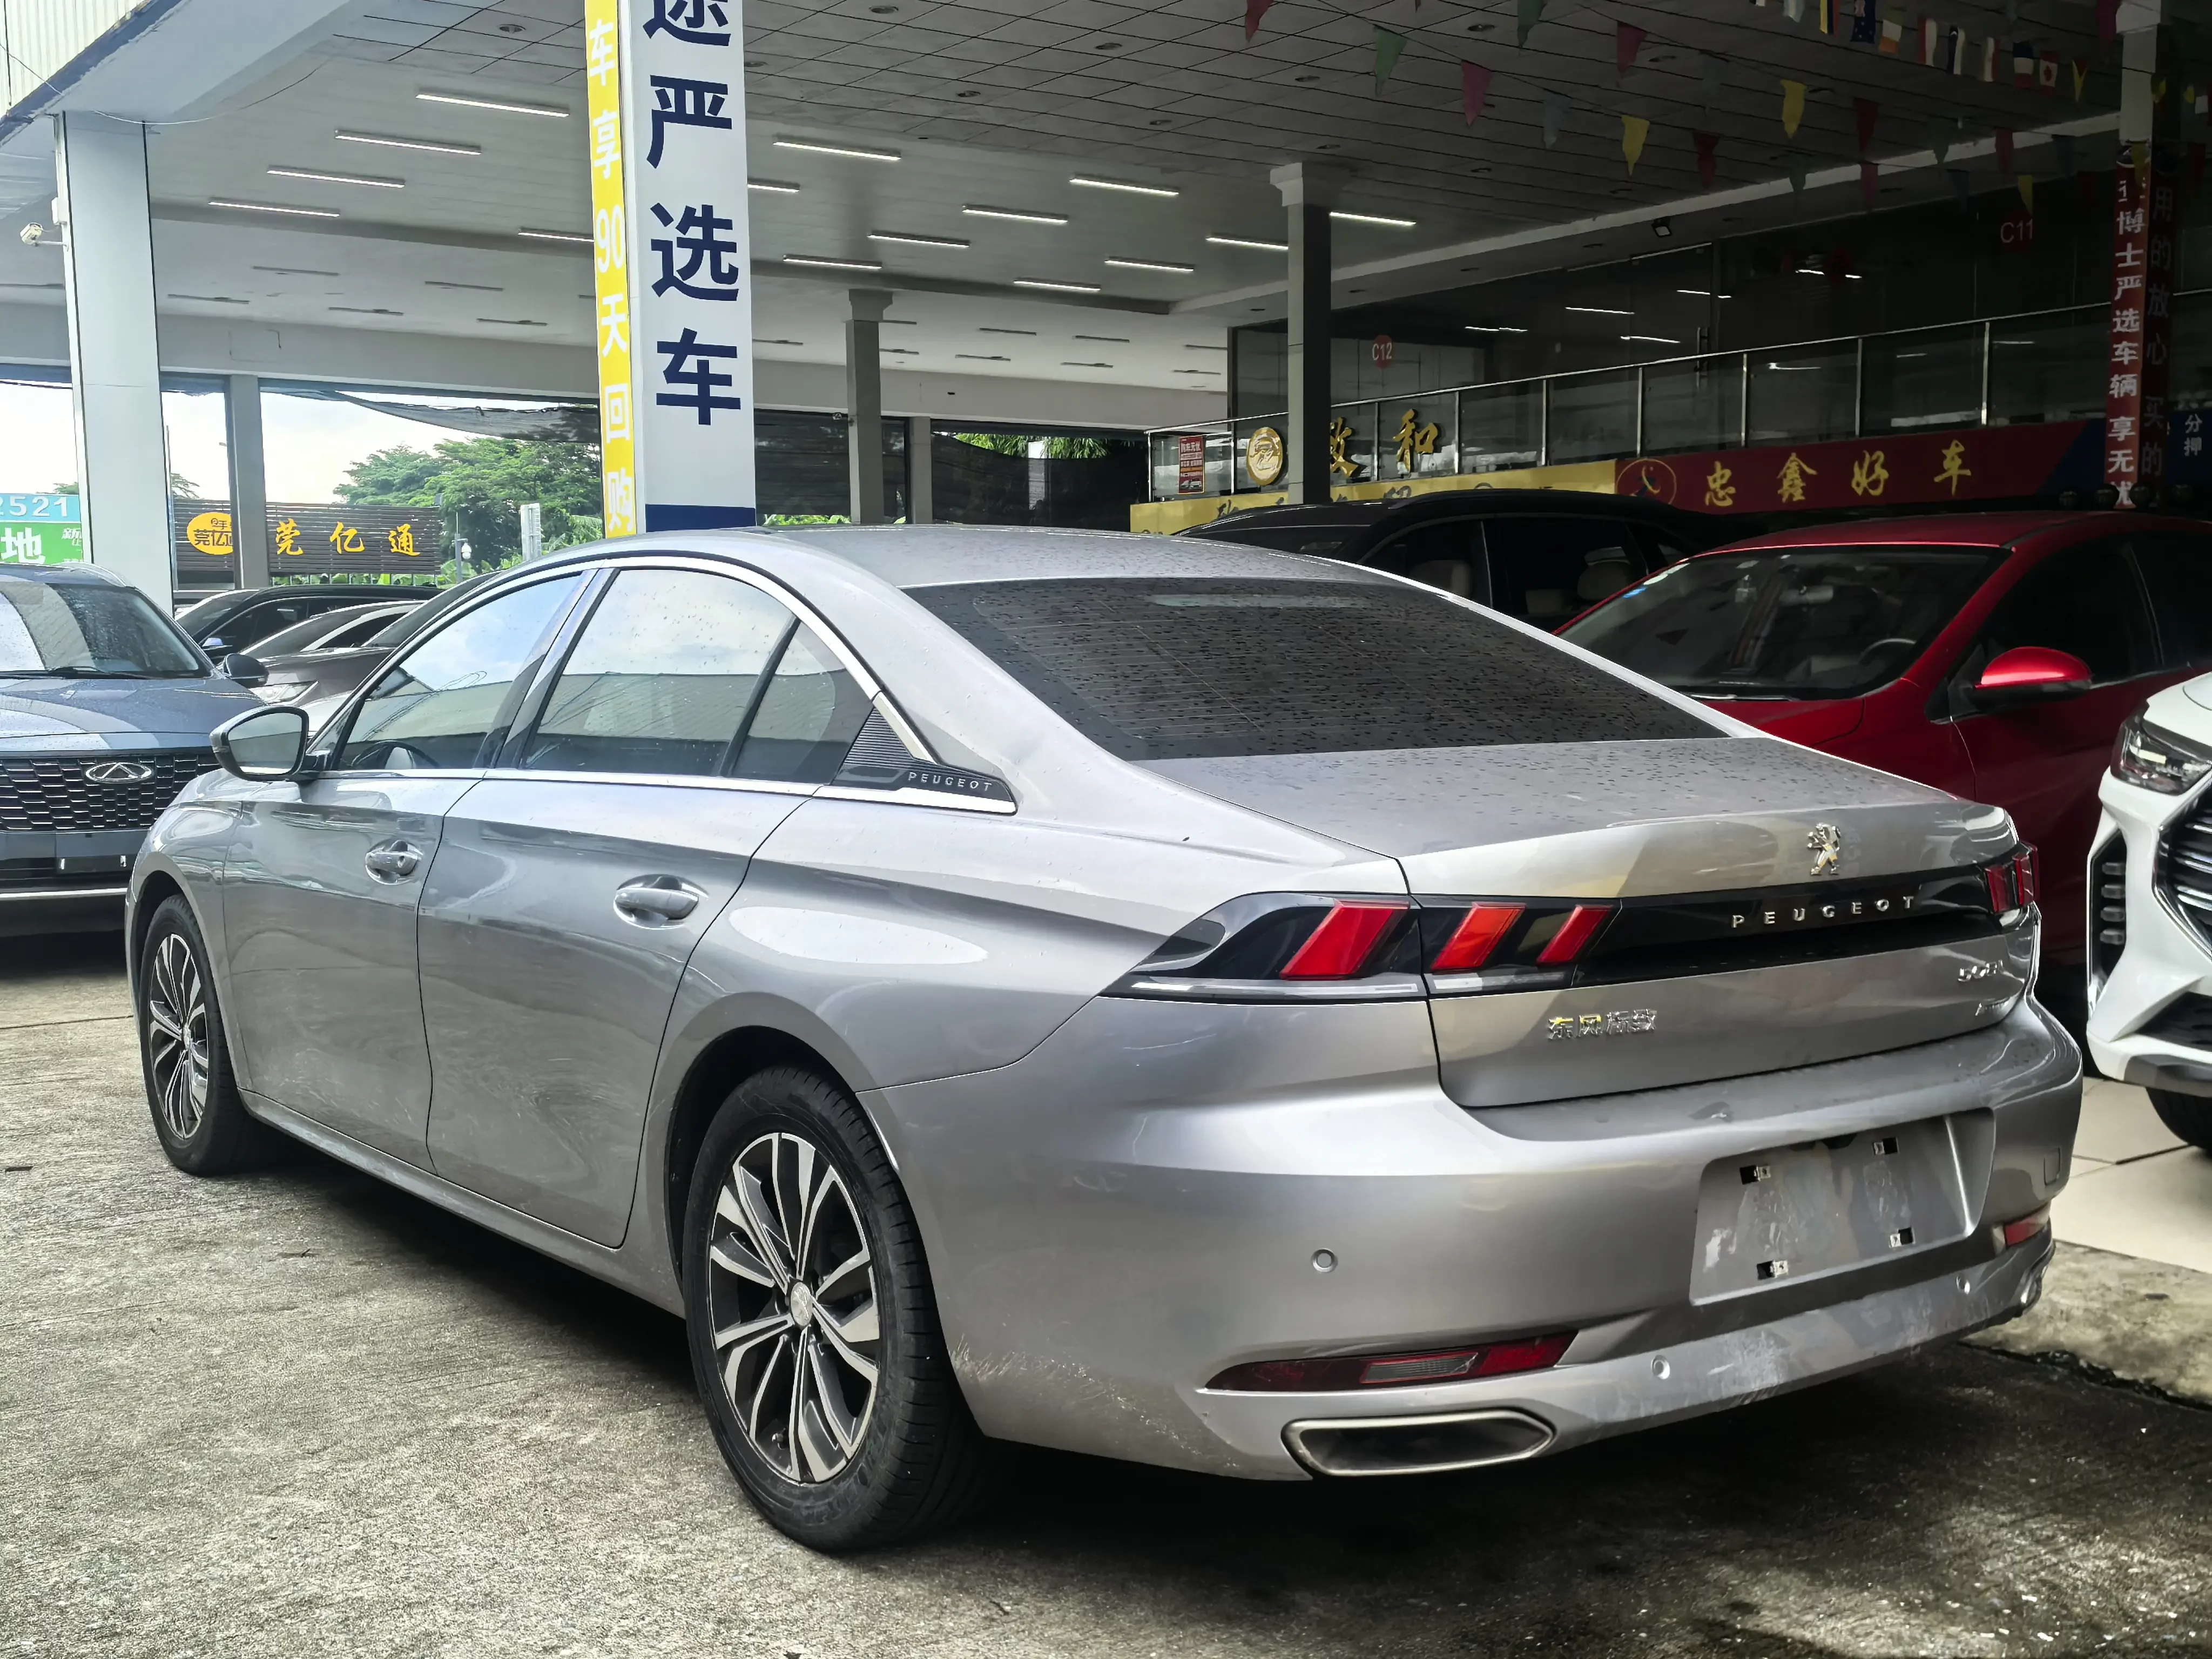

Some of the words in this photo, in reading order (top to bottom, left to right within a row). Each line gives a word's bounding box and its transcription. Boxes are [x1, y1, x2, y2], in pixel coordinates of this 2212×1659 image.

[2000, 218, 2033, 243] C11
[589, 18, 635, 532] 车享90天回购
[1372, 342, 1393, 361] C12
[1704, 439, 1972, 508] 忠鑫好车
[0, 496, 68, 517] 521
[275, 517, 421, 557] 莞亿通
[908, 771, 993, 791] PEUGEOT
[1731, 895, 1914, 928] PEUGEOT
[1547, 1008, 1657, 1040] 东风标致
